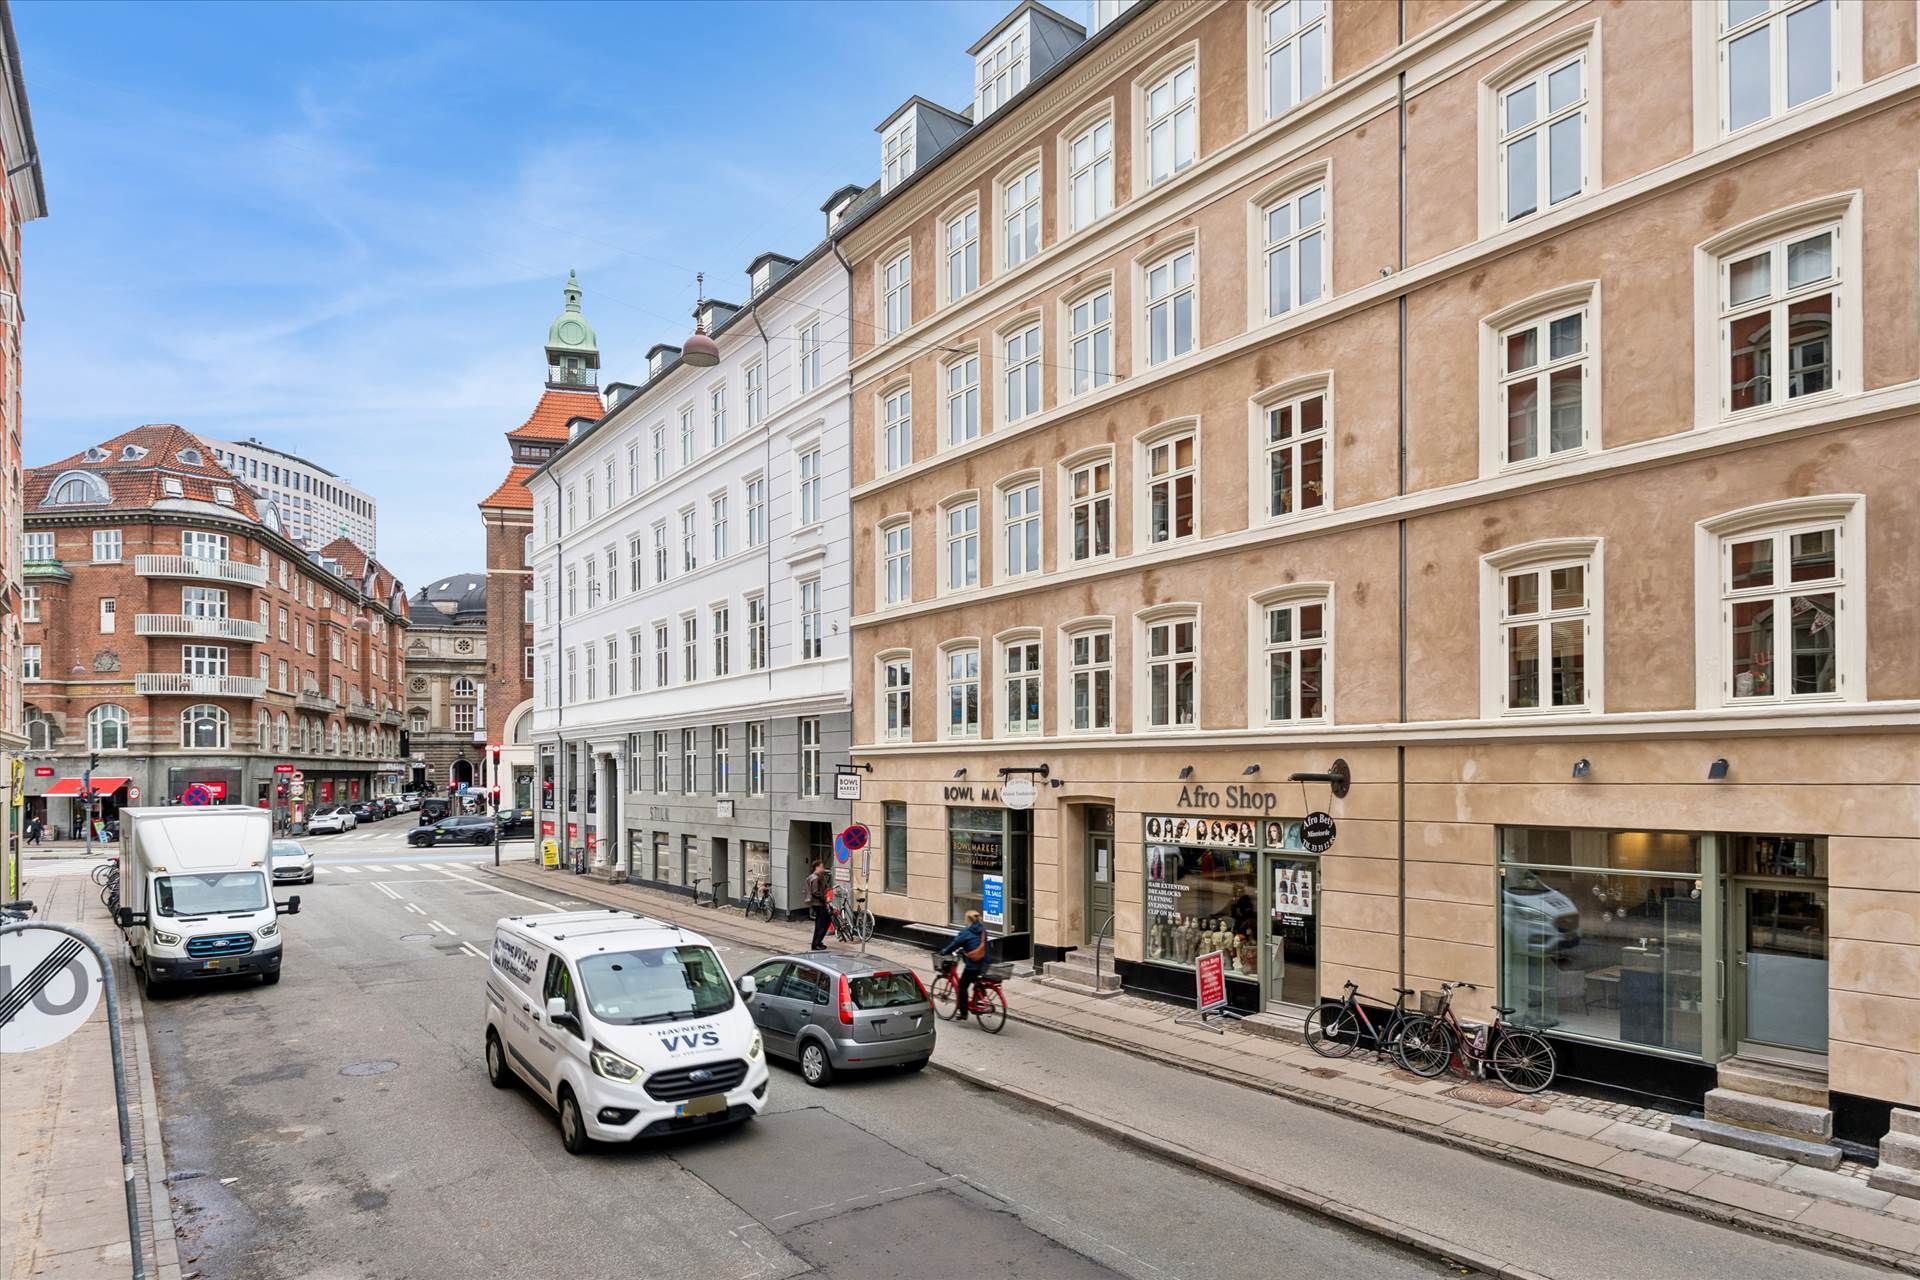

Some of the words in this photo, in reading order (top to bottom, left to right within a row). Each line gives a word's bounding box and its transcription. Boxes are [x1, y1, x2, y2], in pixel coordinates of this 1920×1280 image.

[944, 786, 974, 802] BOWL
[981, 788, 1003, 802] MA
[1177, 785, 1220, 808] Afro
[1226, 785, 1277, 815] Shop
[1304, 816, 1318, 829] Afro
[1319, 814, 1333, 828] Bety
[1148, 889, 1181, 897] DREADLOCKS
[658, 1024, 714, 1036] HAVNENS
[661, 1031, 720, 1052] VVS
